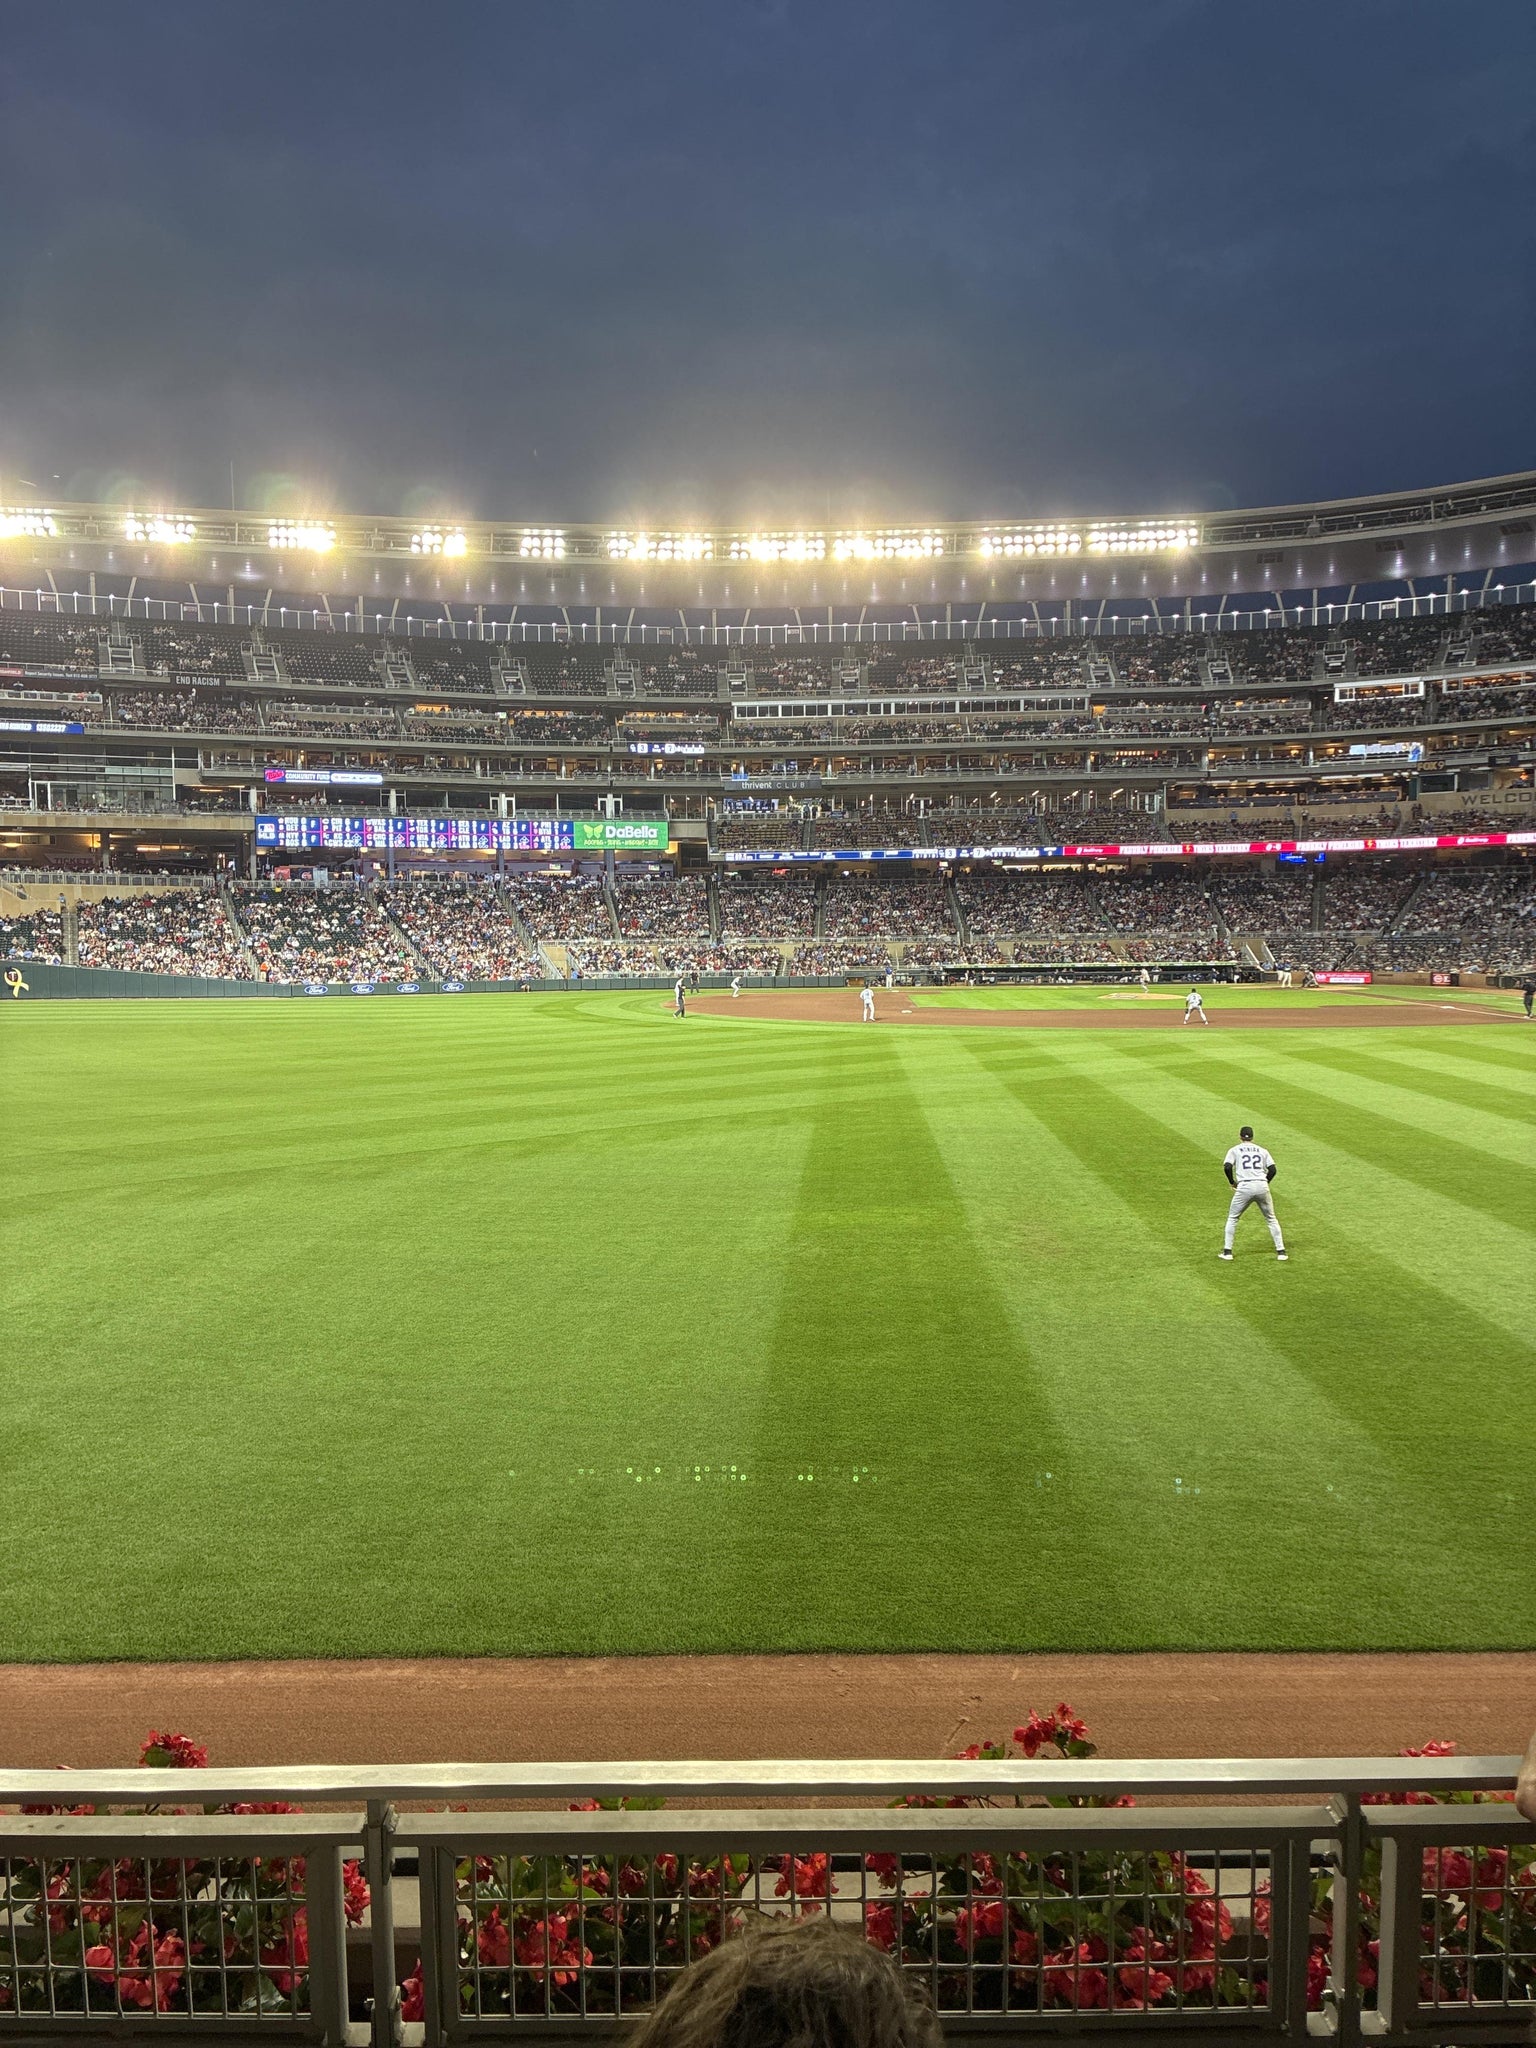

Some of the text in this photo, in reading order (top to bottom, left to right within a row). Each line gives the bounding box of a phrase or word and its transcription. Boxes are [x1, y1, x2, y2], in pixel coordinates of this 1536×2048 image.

[175, 675, 220, 686] END RACISM
[1417, 760, 1445, 771] FOX 9
[285, 772, 316, 780] COMMUNITY
[741, 781, 805, 789] thrivent CLUB
[1461, 791, 1536, 806] WELCO
[605, 825, 659, 839] DaBella
[1241, 1154, 1262, 1170] 22
